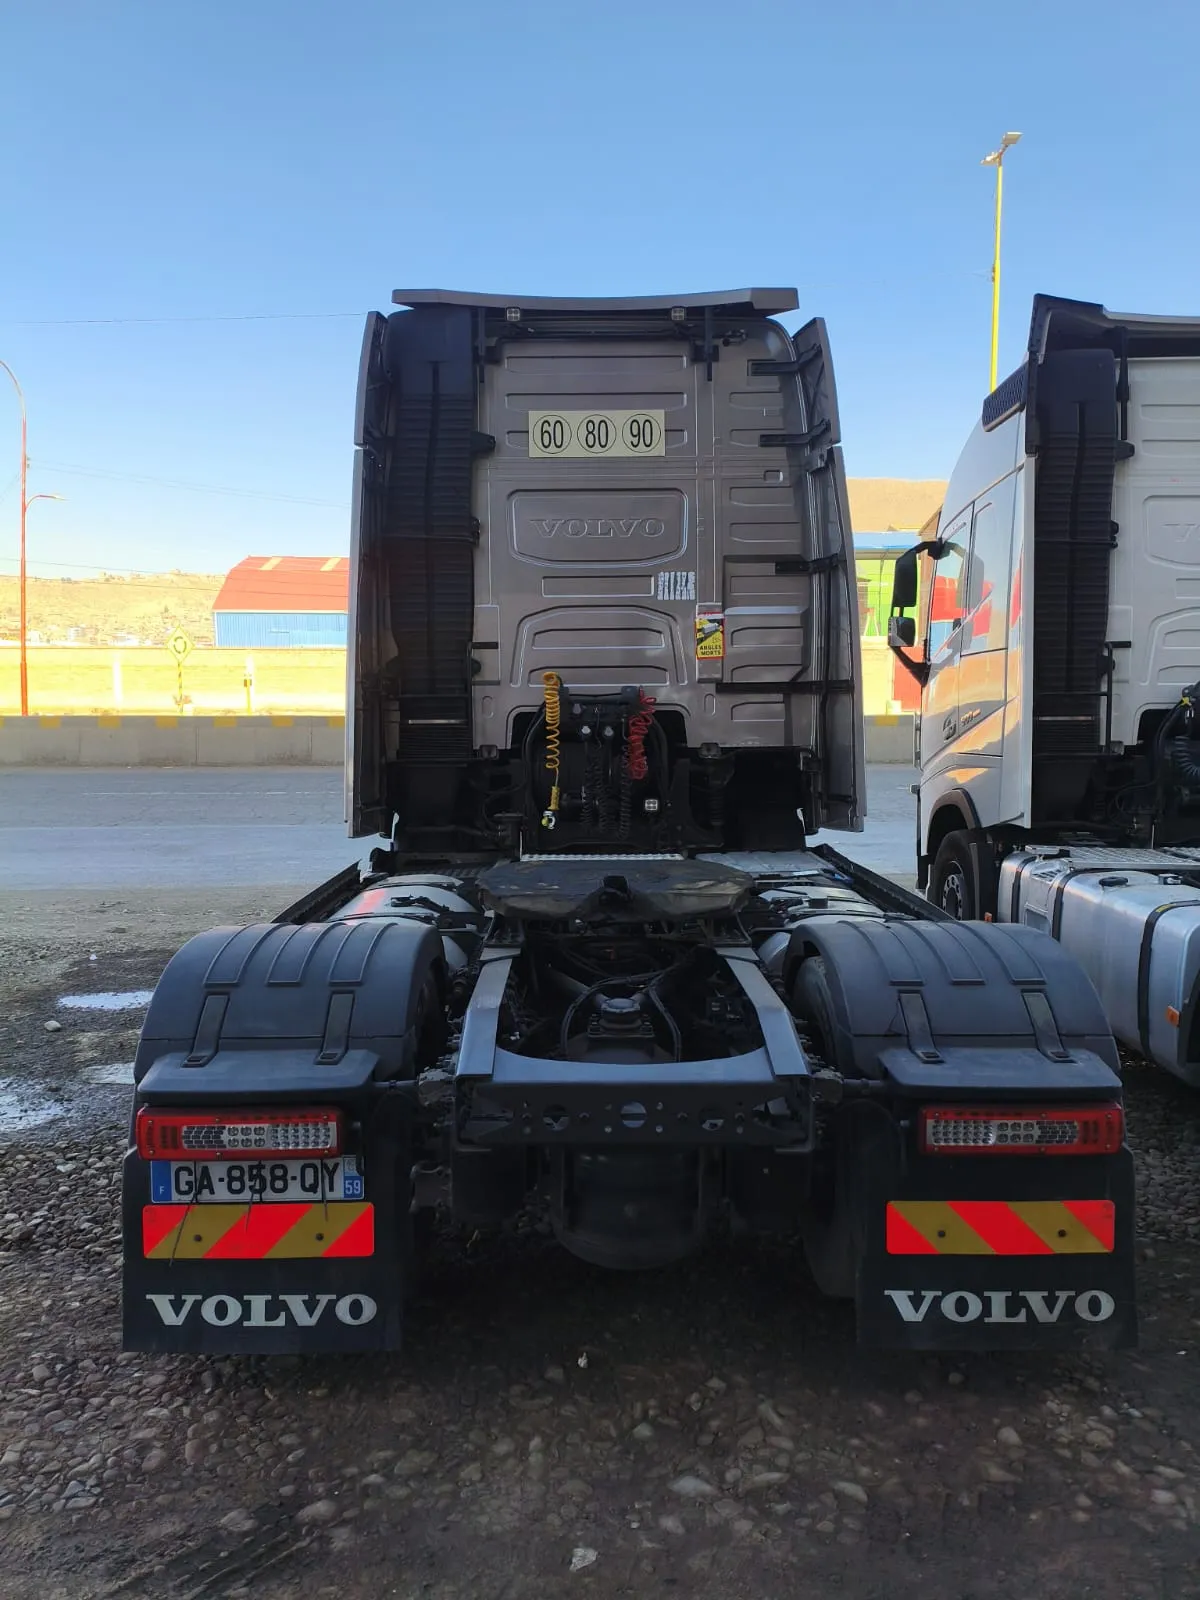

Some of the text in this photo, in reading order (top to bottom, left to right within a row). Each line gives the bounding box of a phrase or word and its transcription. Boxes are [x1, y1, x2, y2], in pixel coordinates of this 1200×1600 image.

[540, 419, 653, 449] 60 80 90
[530, 518, 665, 538] VOLVO
[159, 1186, 165, 1194] F
[174, 1162, 340, 1196] GA-858-QY
[345, 1180, 361, 1194] 59
[145, 1294, 378, 1326] VOLVO
[884, 1290, 1115, 1323] VOLVO
